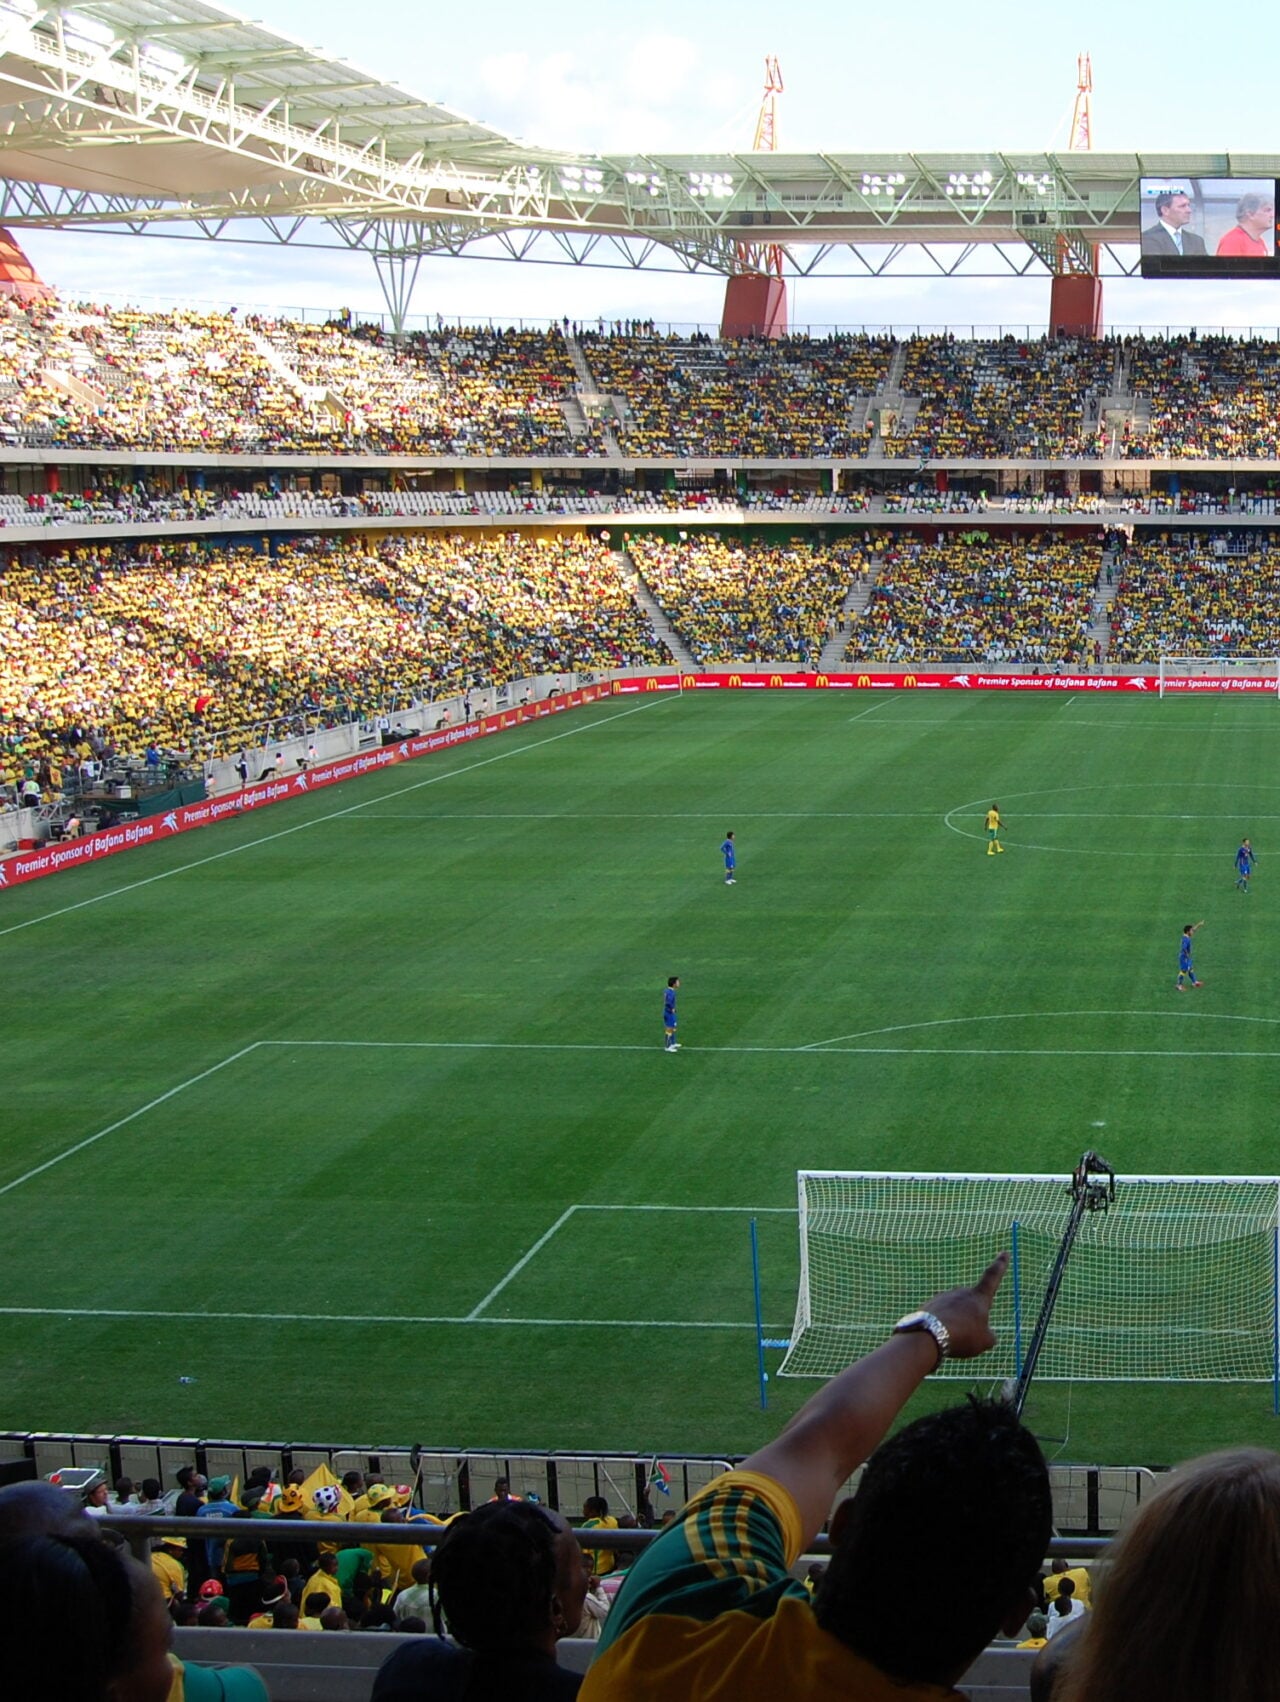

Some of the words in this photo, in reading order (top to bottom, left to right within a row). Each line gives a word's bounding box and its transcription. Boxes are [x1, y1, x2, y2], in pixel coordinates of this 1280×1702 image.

[978, 677, 1009, 686] Premier
[1011, 677, 1043, 689] Sponsor
[1044, 677, 1053, 689] of
[1055, 677, 1085, 689] Bafana
[1087, 677, 1118, 689] Bafana
[1188, 679, 1220, 689] Sponsor
[1221, 679, 1230, 689] of
[1231, 679, 1262, 689] Bafana
[183, 807, 210, 823] Premier
[210, 800, 236, 818] Sponsor
[236, 794, 244, 808] of
[243, 790, 266, 806] Bafana
[266, 783, 289, 799] Bafana
[16, 855, 50, 876] Premier
[50, 844, 84, 868] Sponsor
[84, 840, 93, 857] of
[95, 833, 124, 852] Bafana
[125, 824, 154, 843] Bafana
